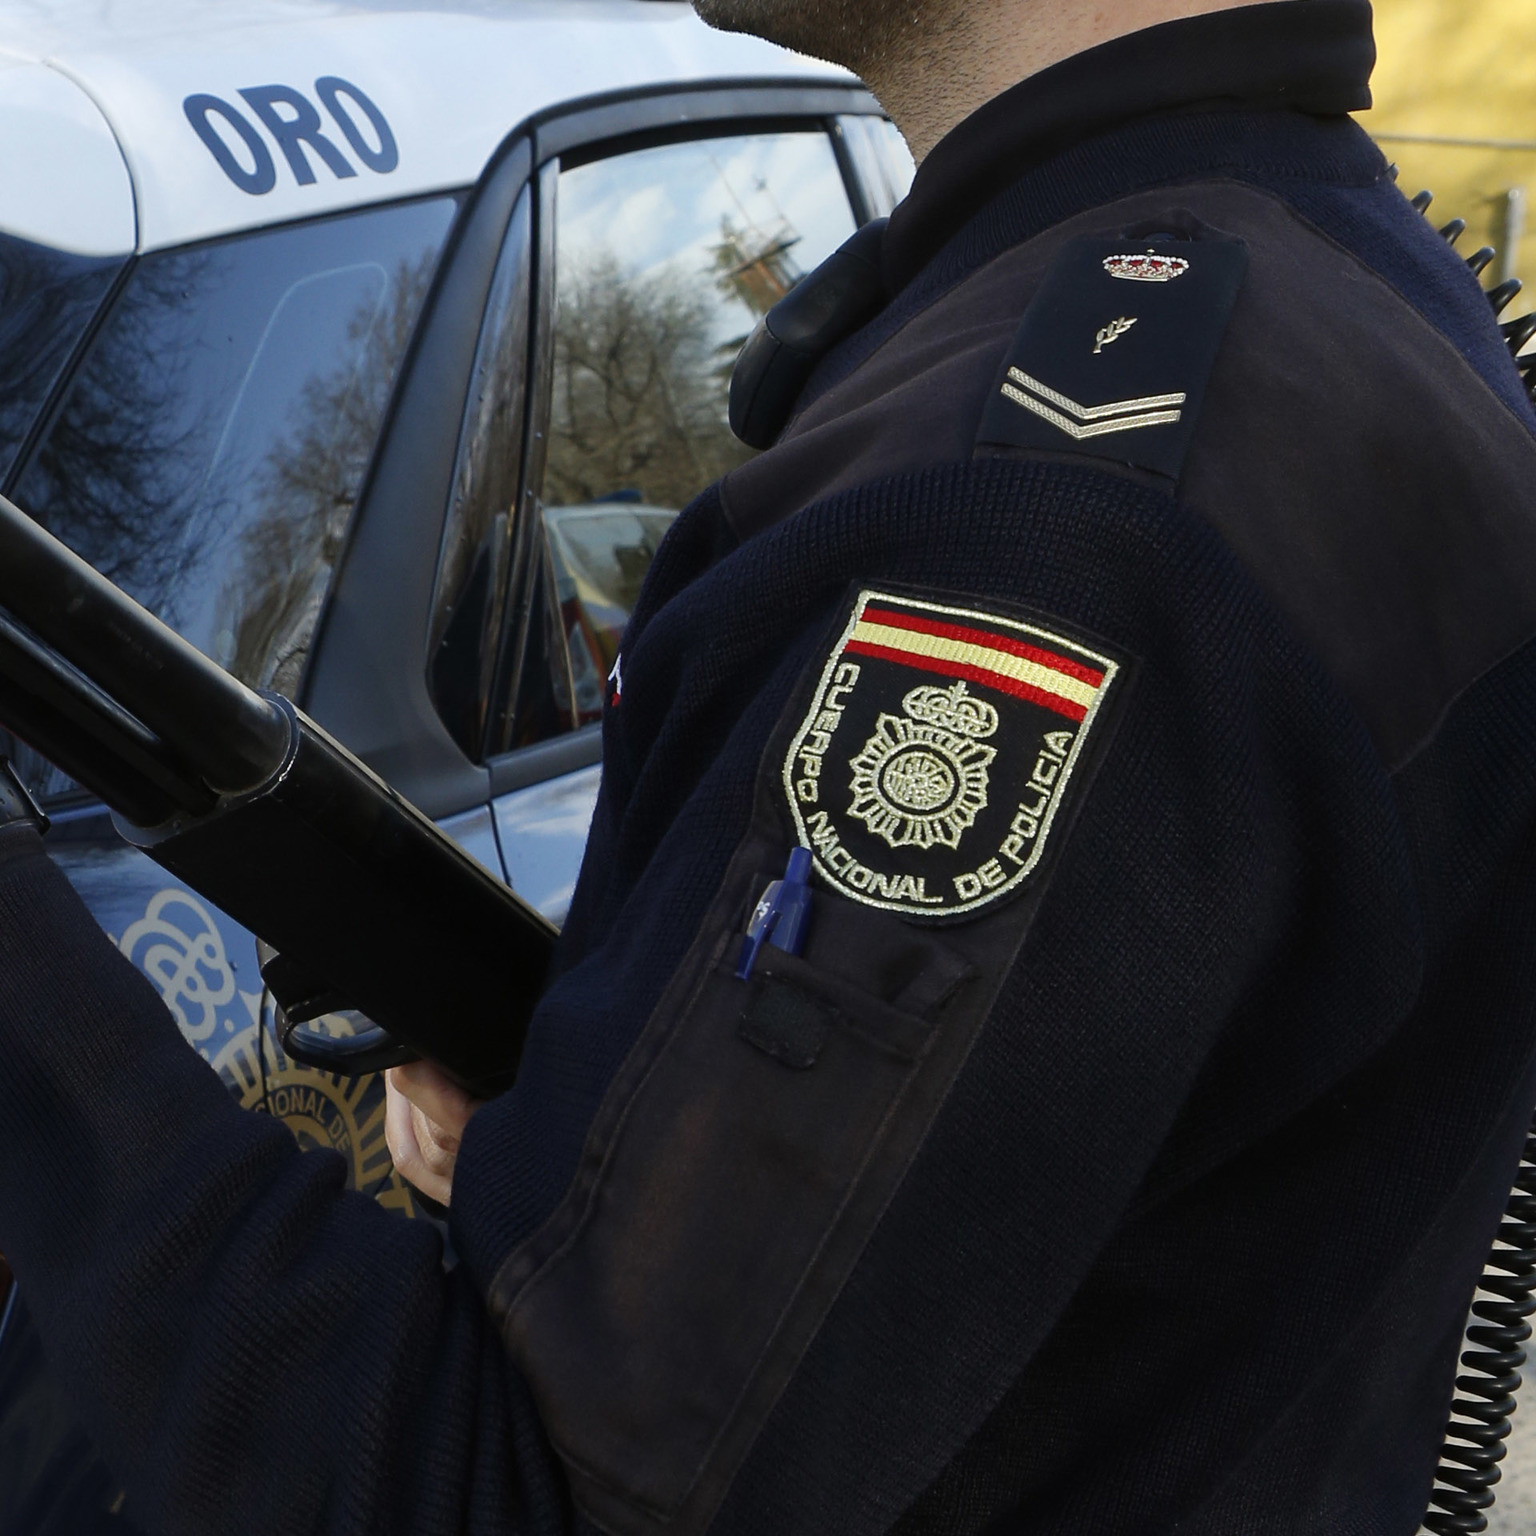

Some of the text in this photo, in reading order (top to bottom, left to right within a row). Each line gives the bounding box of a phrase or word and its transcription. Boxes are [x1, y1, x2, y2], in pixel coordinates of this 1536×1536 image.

[182, 75, 399, 195] ORO
[797, 662, 1073, 903] CUERPO NACIONAL DE POLICIA
